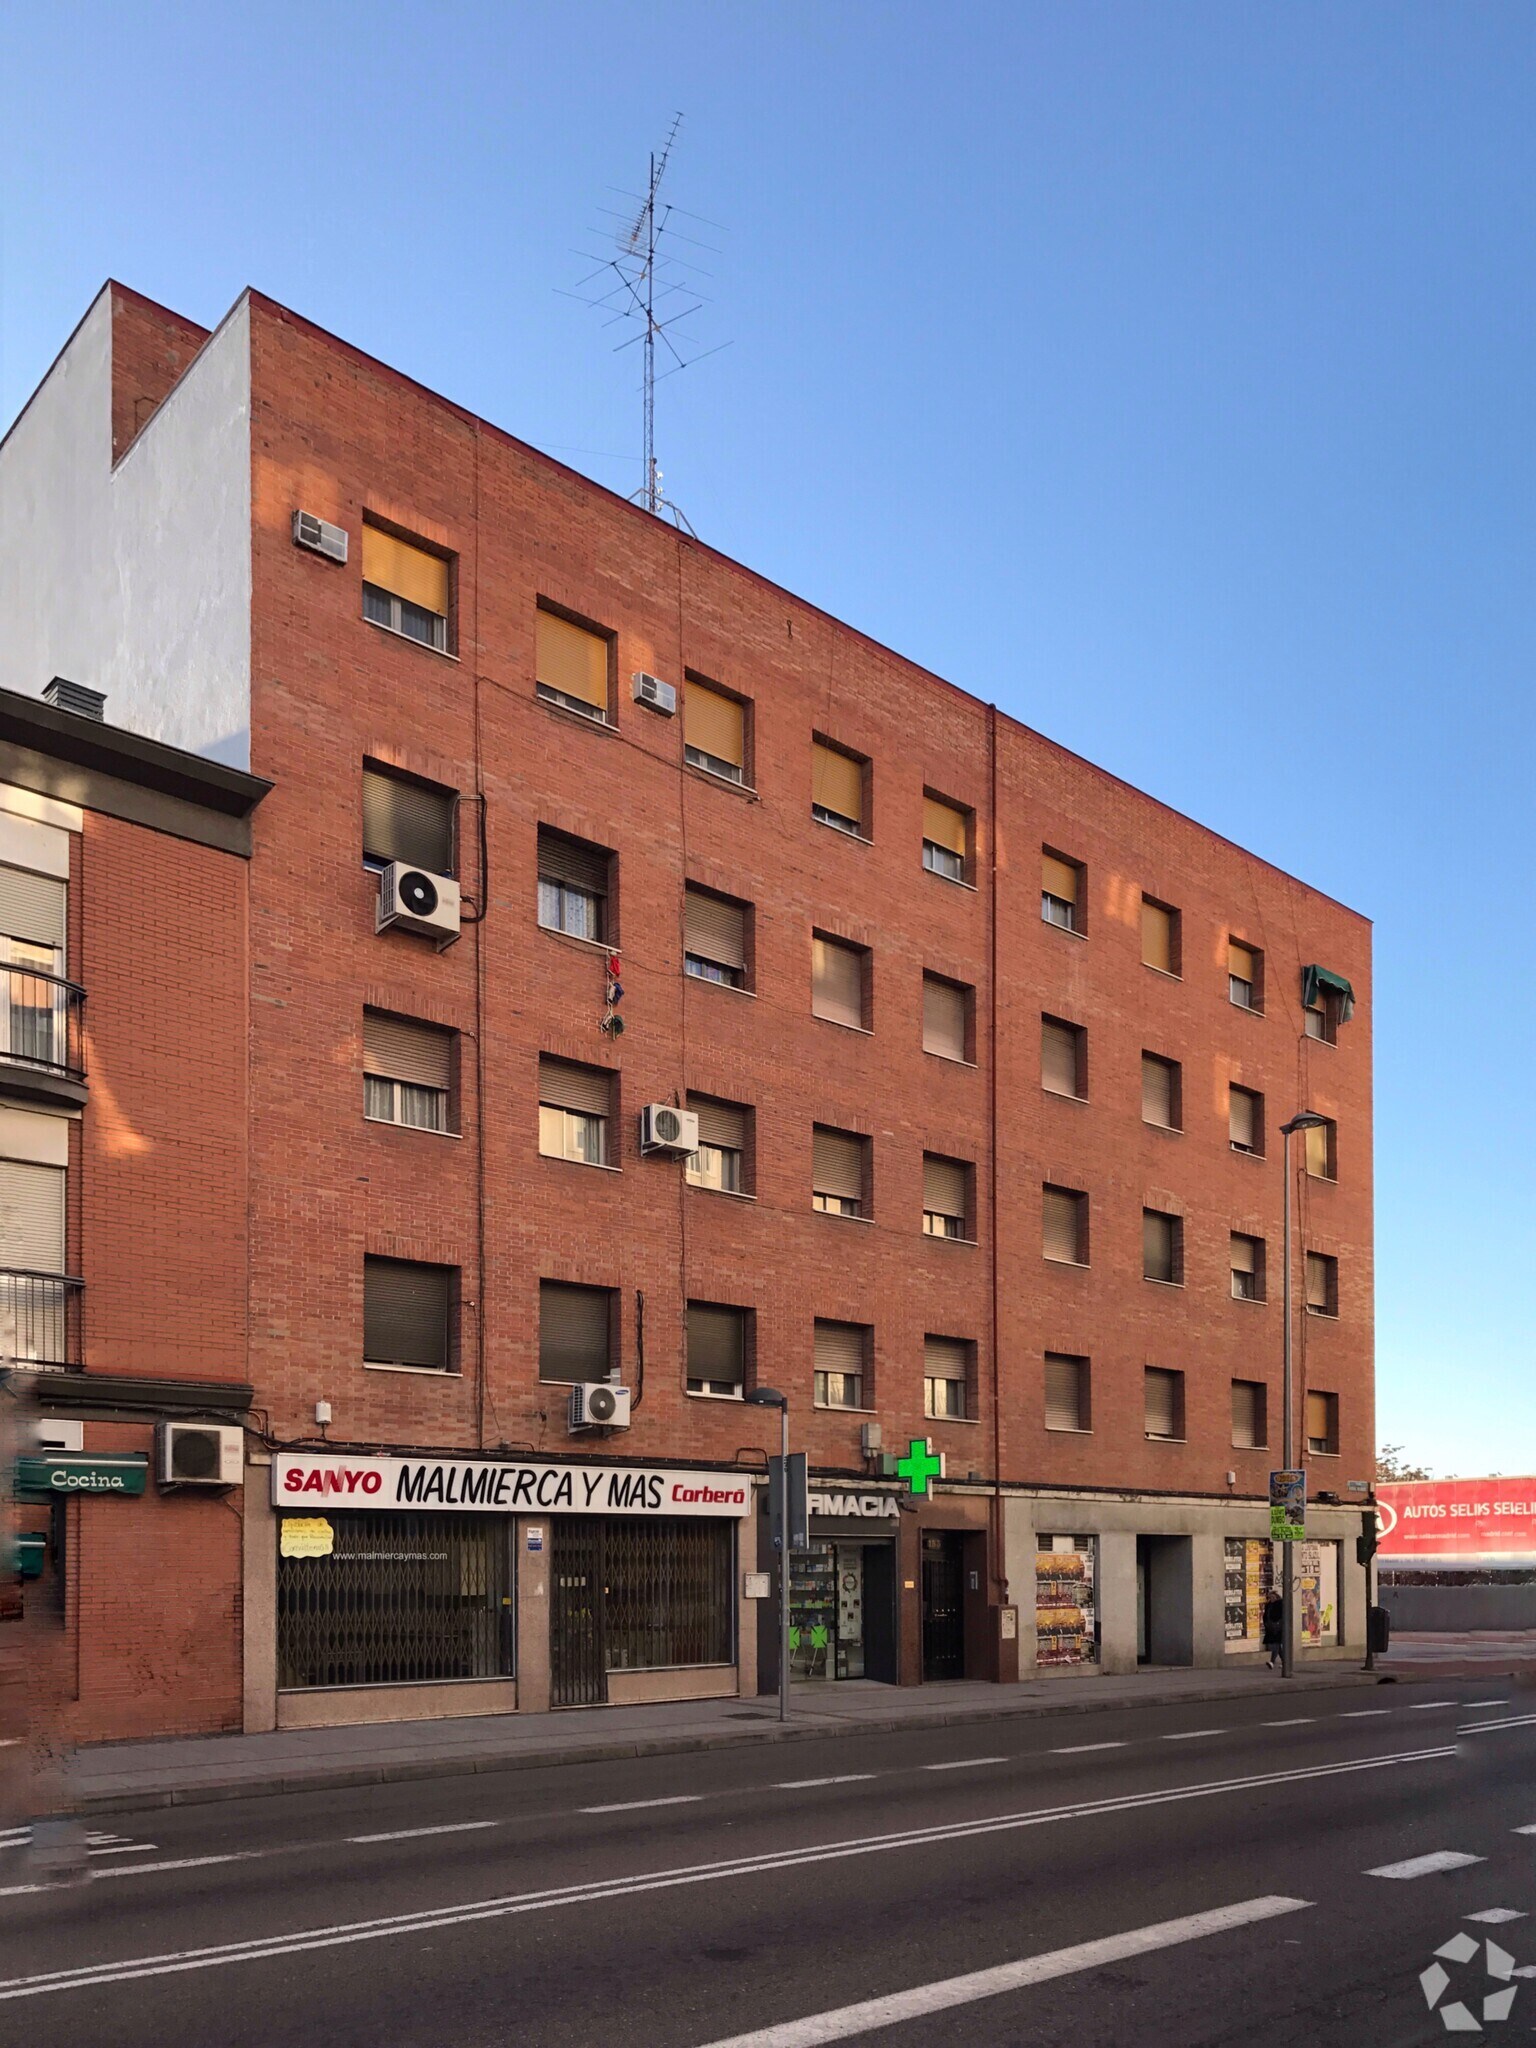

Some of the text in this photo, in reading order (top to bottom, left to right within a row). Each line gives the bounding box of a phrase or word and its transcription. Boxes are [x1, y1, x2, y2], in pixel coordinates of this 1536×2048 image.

[50, 1470, 124, 1487] Cocina
[284, 1465, 382, 1498] SANYO
[396, 1464, 665, 1509] MALMIERCA Y MAS
[808, 1494, 900, 1517] RMACIA
[1403, 1504, 1447, 1519] AUTOS
[332, 1551, 448, 1561] www.malmiercaymas.com
